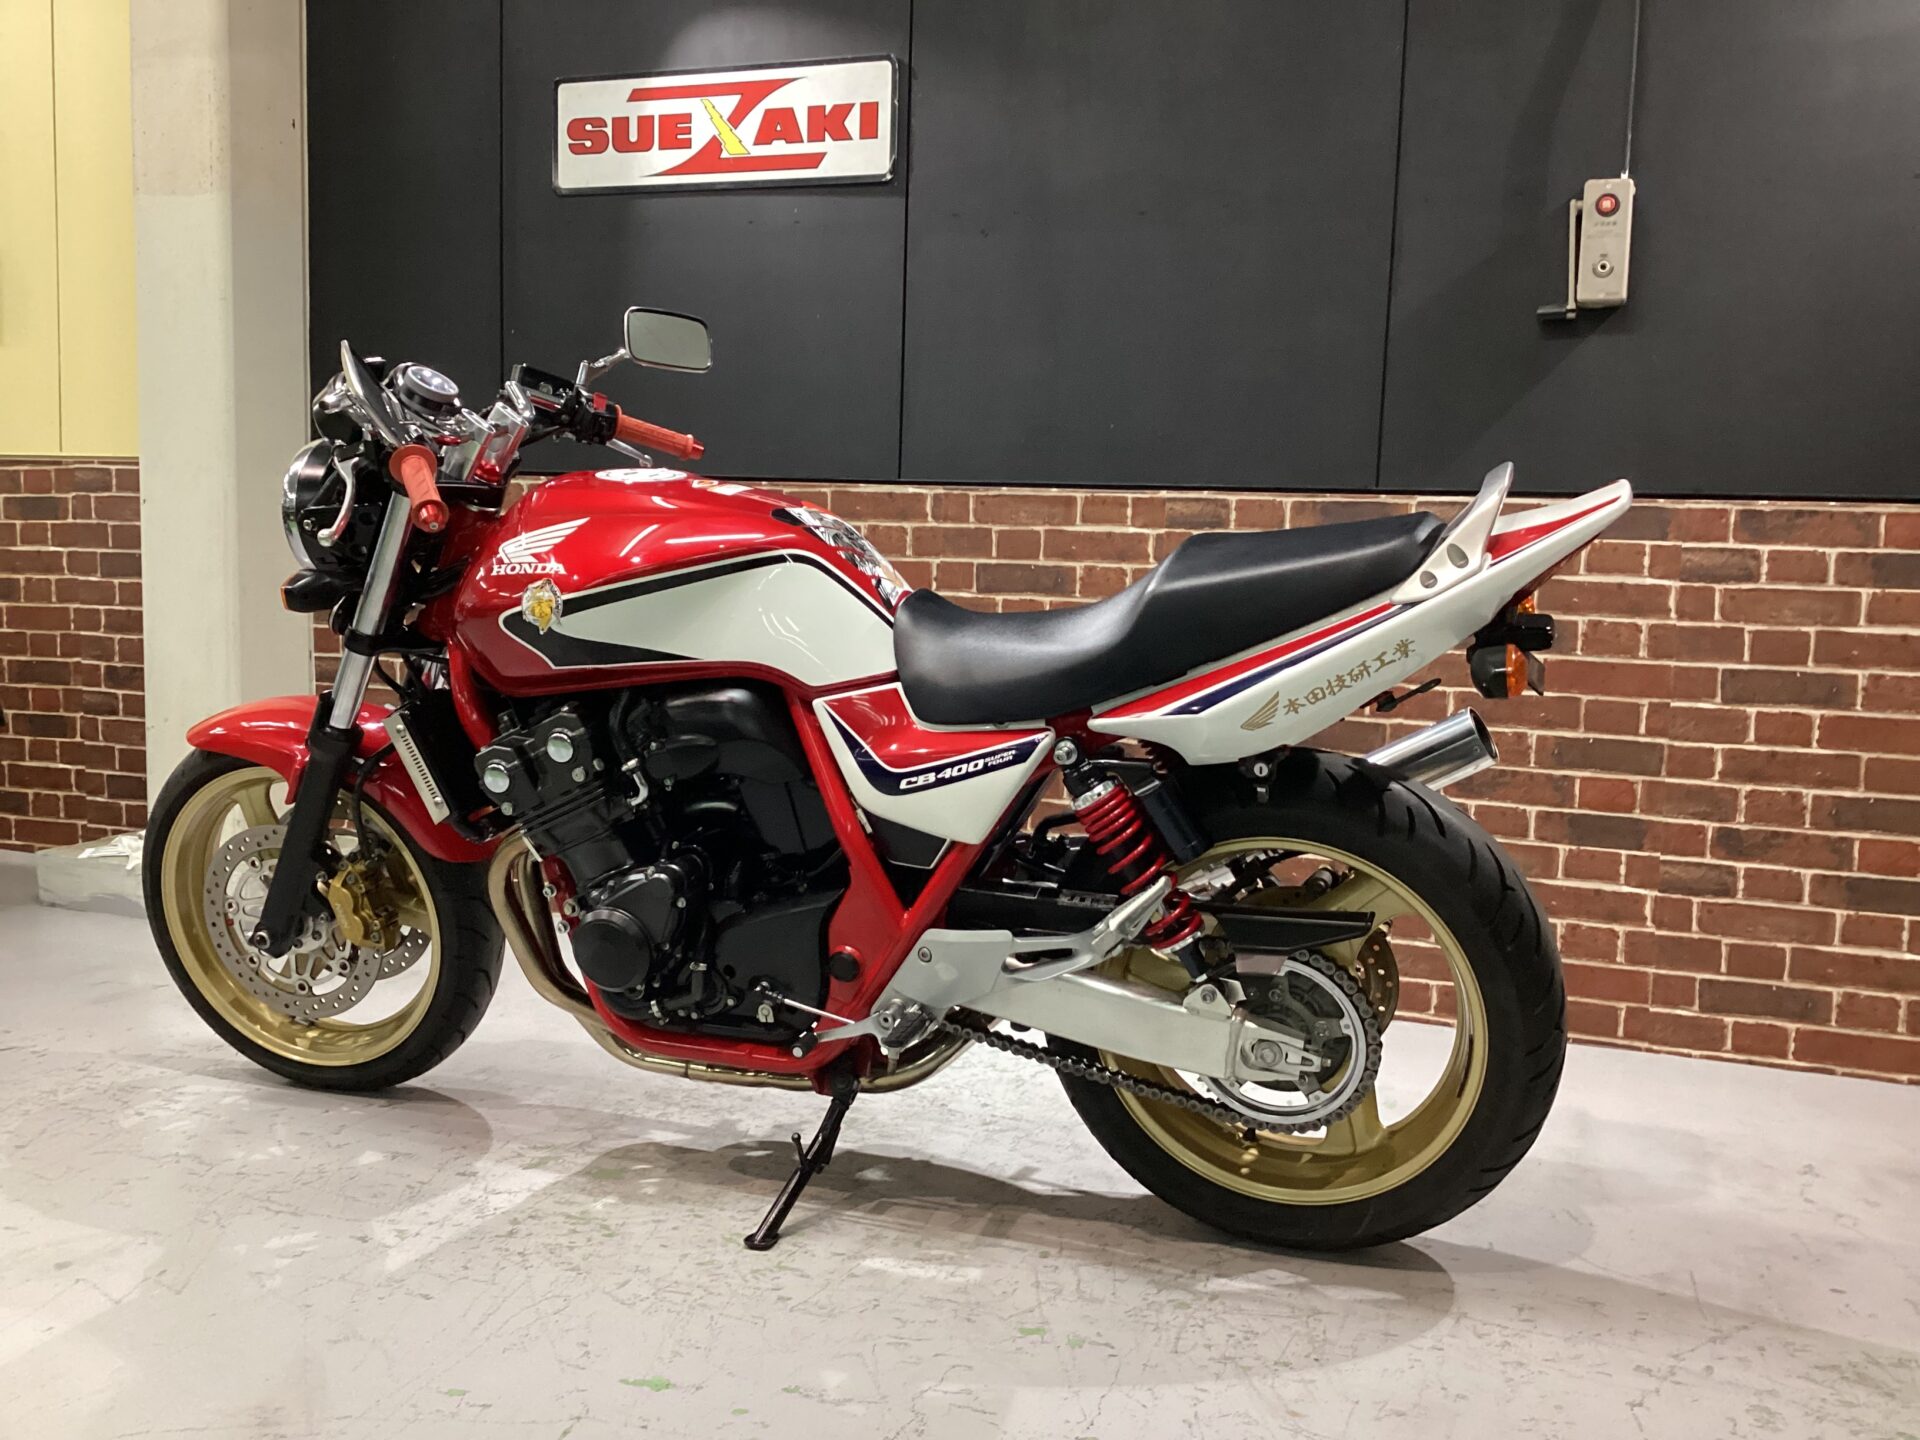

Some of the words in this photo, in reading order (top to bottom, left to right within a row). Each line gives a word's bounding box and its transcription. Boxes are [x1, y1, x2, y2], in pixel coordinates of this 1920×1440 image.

[566, 77, 879, 177] SUEZAKI
[491, 563, 567, 576] HONDA
[1283, 638, 1416, 715] 本田技研工業
[899, 759, 984, 789] CB400
[985, 750, 1016, 763] SUPER
